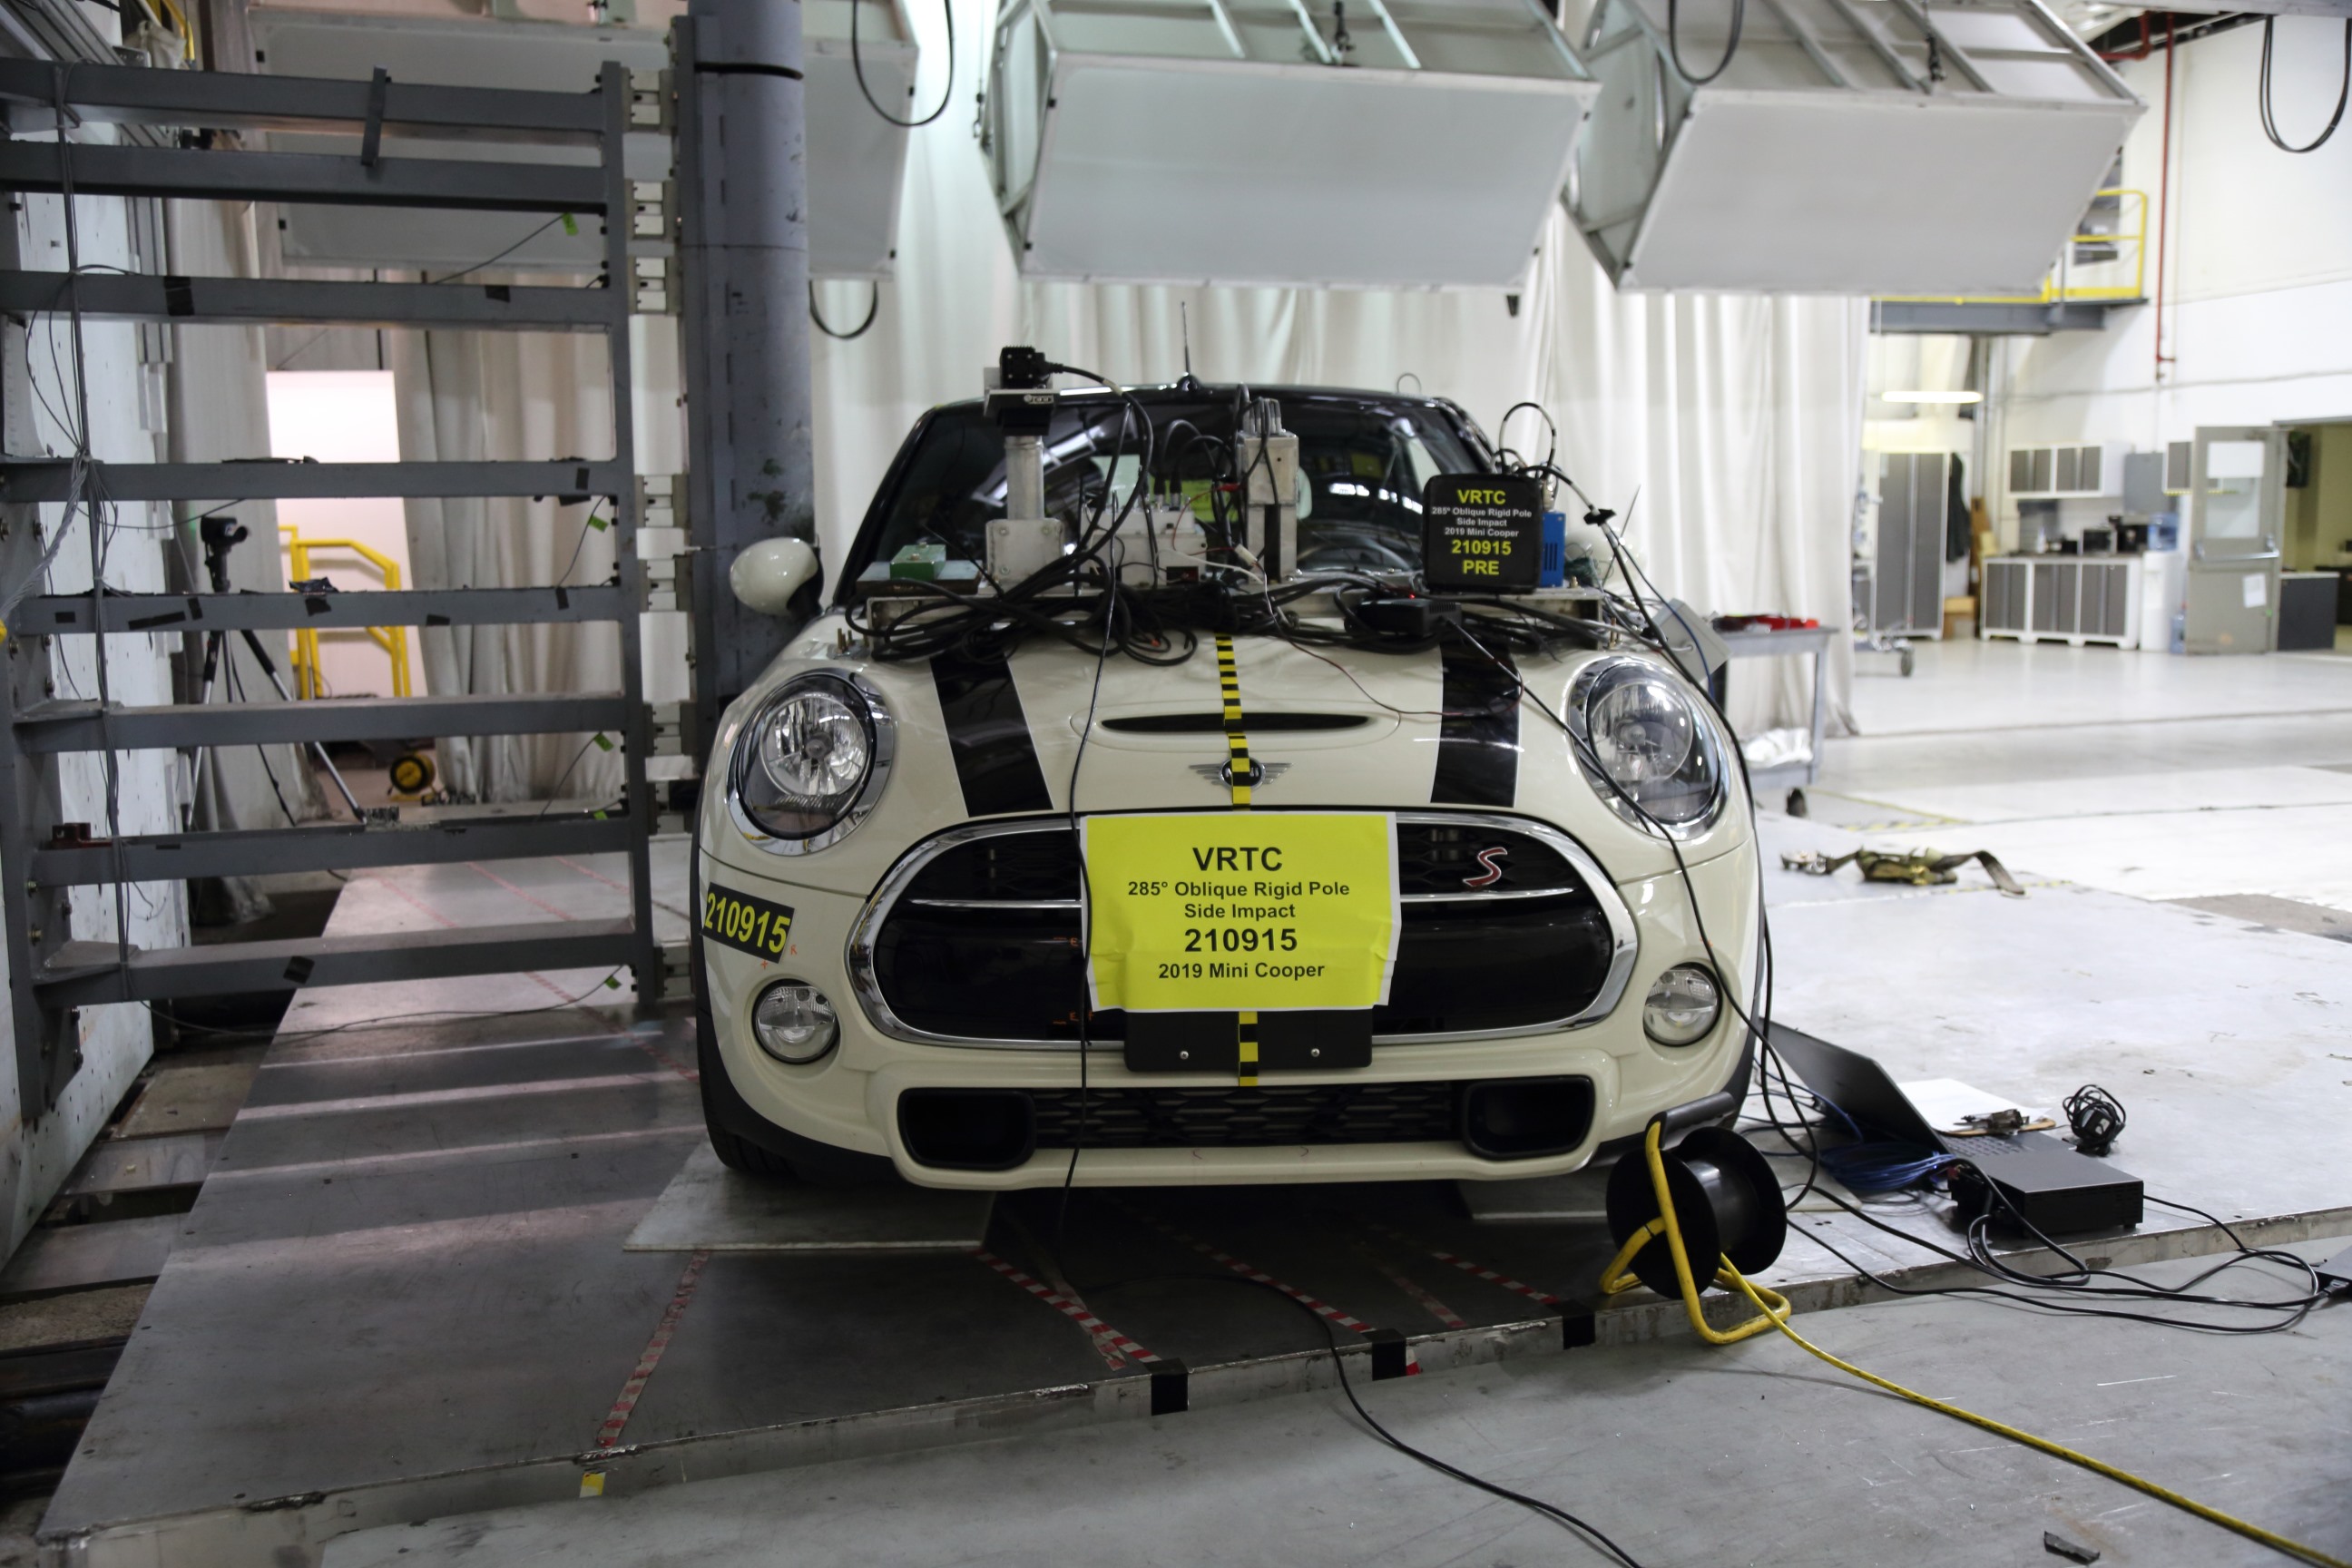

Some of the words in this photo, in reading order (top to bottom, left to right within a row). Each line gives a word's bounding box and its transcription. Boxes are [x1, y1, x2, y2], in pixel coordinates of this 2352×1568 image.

[1457, 490, 1506, 505] VRTC
[1452, 507, 1486, 517] Oblique
[1487, 508, 1511, 518] Rigid
[1513, 509, 1533, 518] Pole
[1456, 517, 1476, 526] Side
[1477, 518, 1507, 528] Impact
[1444, 527, 1465, 536] 2019
[1466, 528, 1485, 537] Mini
[1487, 529, 1520, 539] Cooper
[1451, 539, 1512, 556] 210915
[1463, 559, 1500, 575] PRE
[1192, 847, 1283, 872] VRTC
[1462, 846, 1508, 887] S
[1128, 881, 1169, 896] 285°
[1174, 881, 1248, 900] Oblique
[1254, 881, 1302, 900] Rigid
[1308, 881, 1350, 896] Pole
[1184, 903, 1226, 918] Side
[1231, 903, 1297, 921] Impact
[704, 892, 791, 954] 210915
[1184, 927, 1298, 953] 210915
[1159, 963, 1203, 979] 2019
[1209, 962, 1249, 978] Mini
[1255, 962, 1326, 981] Cooper
